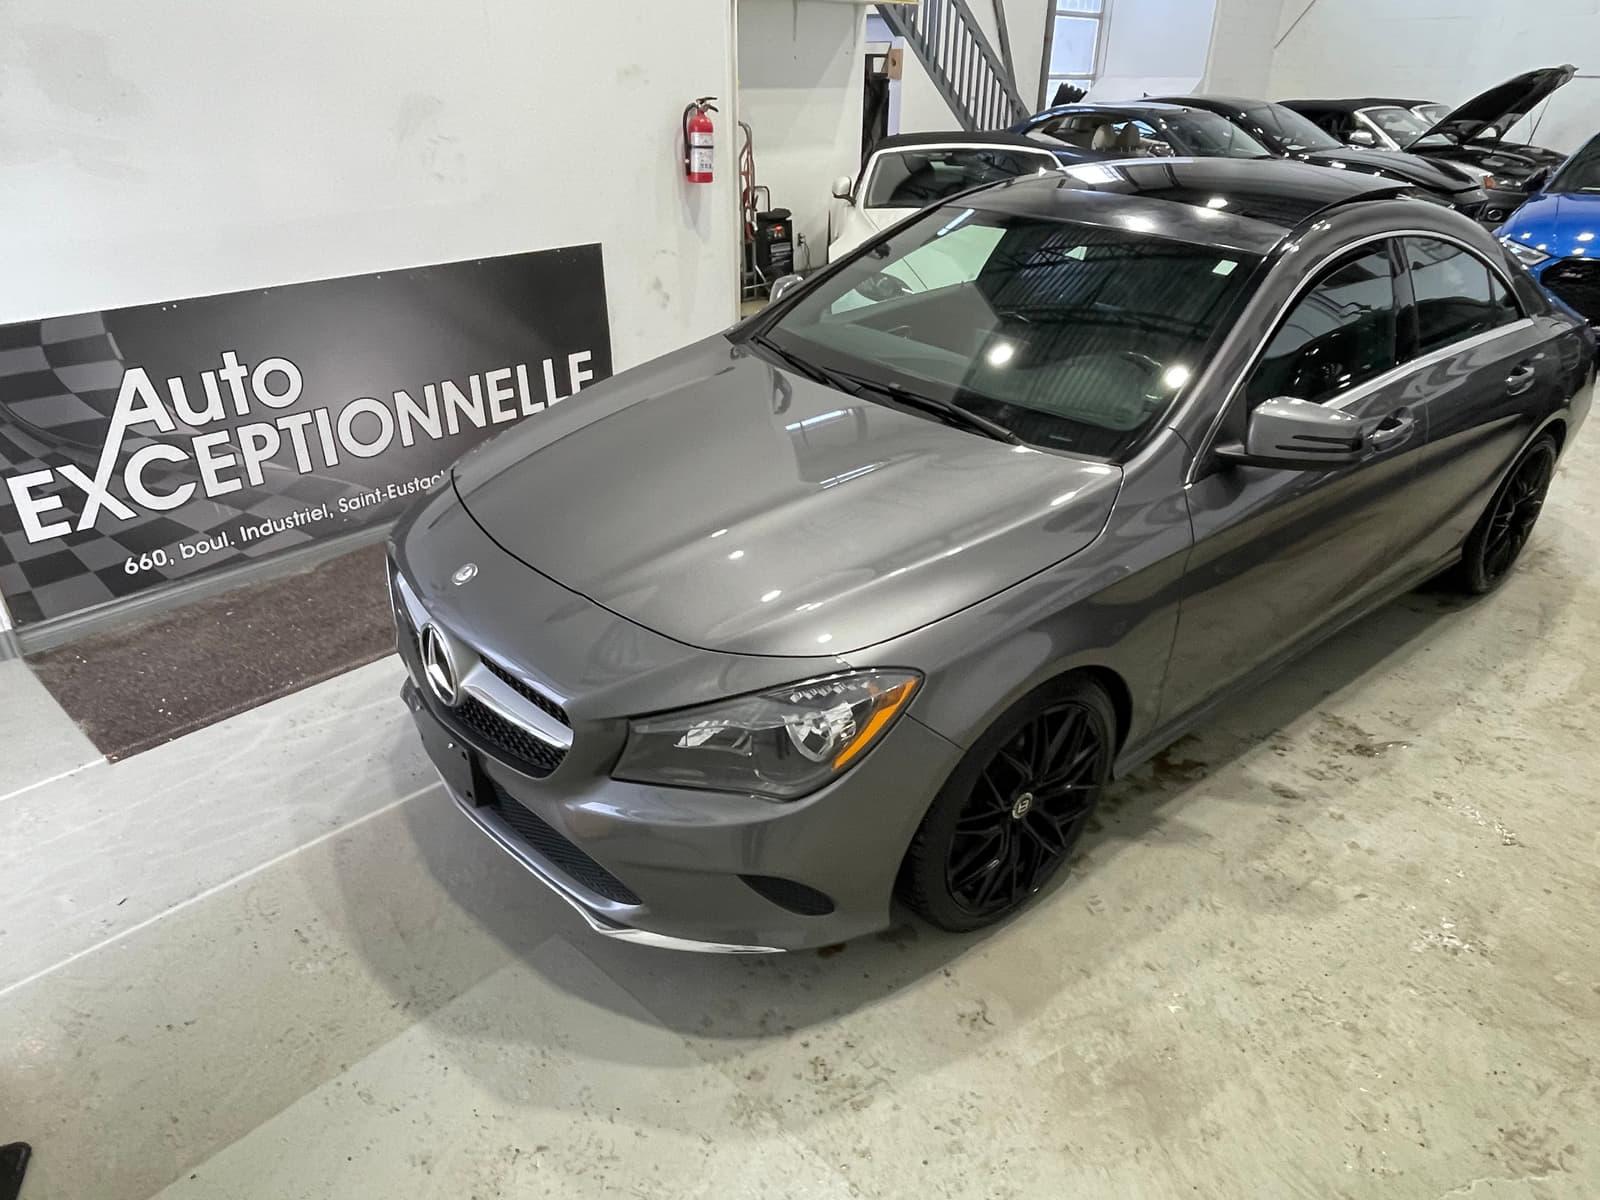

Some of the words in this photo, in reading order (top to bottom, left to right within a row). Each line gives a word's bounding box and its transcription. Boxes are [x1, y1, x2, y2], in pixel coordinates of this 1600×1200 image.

[110, 350, 303, 433] Auto
[124, 549, 175, 575] 660,
[179, 531, 235, 559] boul.
[240, 503, 334, 542] Industriel,
[338, 469, 445, 513] Saint-Eustac
